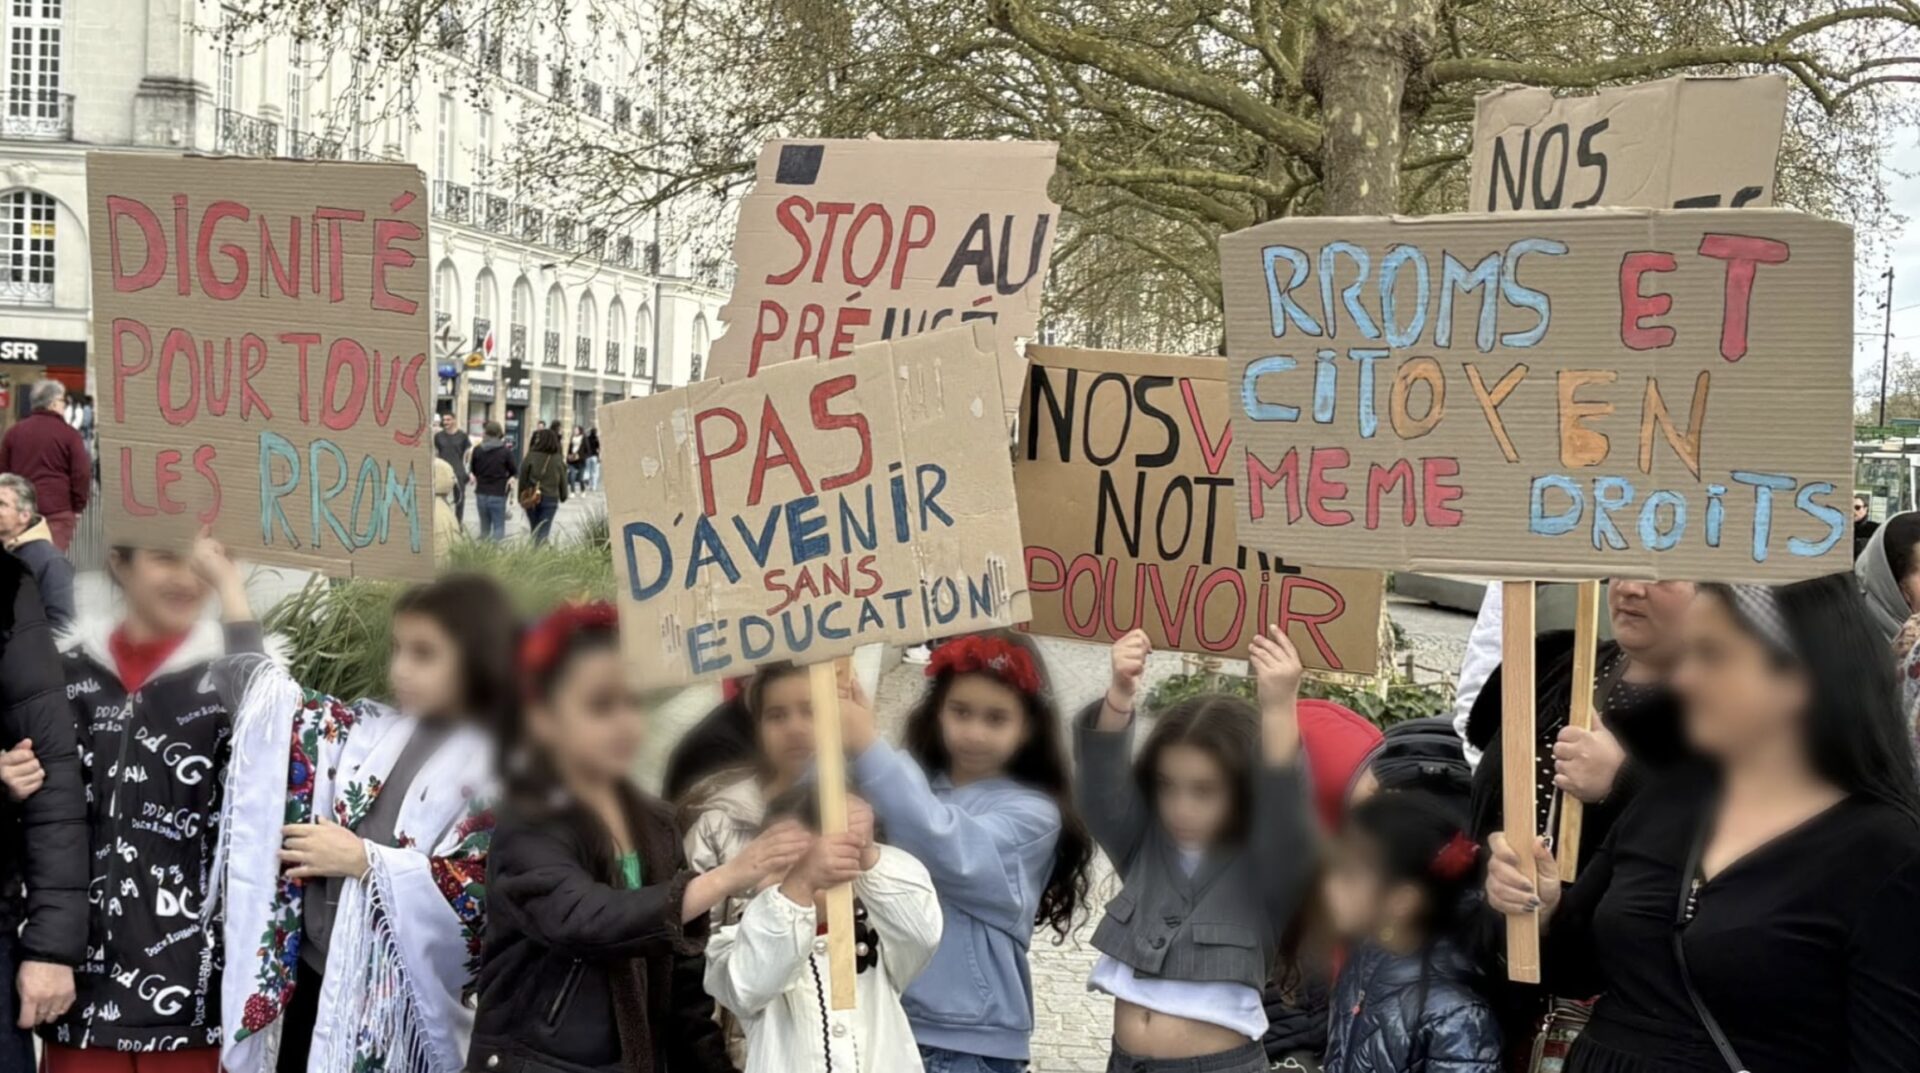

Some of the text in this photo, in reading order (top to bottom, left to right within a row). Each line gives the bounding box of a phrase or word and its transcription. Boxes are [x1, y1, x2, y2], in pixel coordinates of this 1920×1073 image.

[1487, 117, 1610, 212] NOS
[765, 195, 1050, 295] STOP AU
[1261, 233, 1791, 362] RROMS ET
[0, 341, 39, 361] SFR
[693, 373, 874, 518] PAS
[1026, 364, 1181, 468] NOS
[119, 430, 422, 554] LES RROM
[1094, 469, 1302, 575] NOT
[1245, 444, 1464, 530] MEME
[763, 554, 883, 617] SANS
